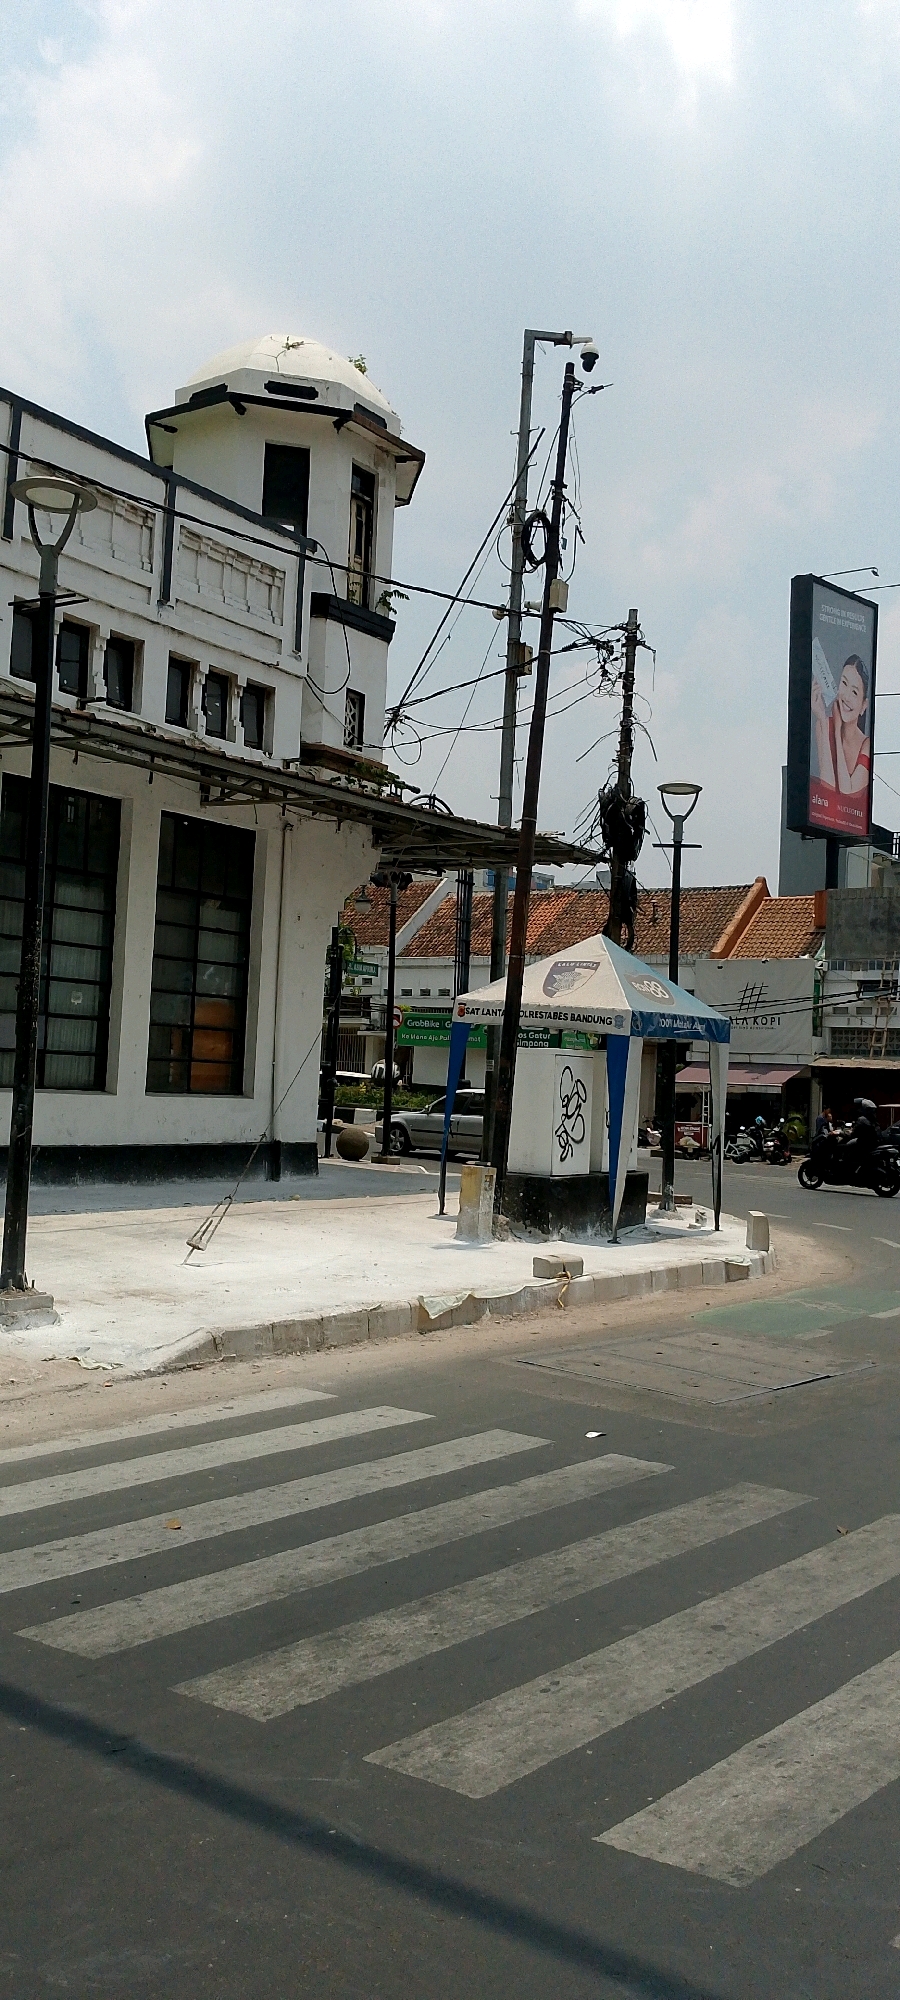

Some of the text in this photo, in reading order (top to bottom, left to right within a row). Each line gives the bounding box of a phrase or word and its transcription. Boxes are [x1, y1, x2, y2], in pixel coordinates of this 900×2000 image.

[821, 604, 841, 616] STRONG
[840, 609, 847, 617] IN
[819, 613, 837, 625] GENTLE
[465, 1007, 613, 1025] SAT LANTA OLRESTABES BANDUNG
[753, 1016, 781, 1026] KOPI
[407, 1019, 440, 1028] GrabBike
[528, 1031, 551, 1040] Gatur
